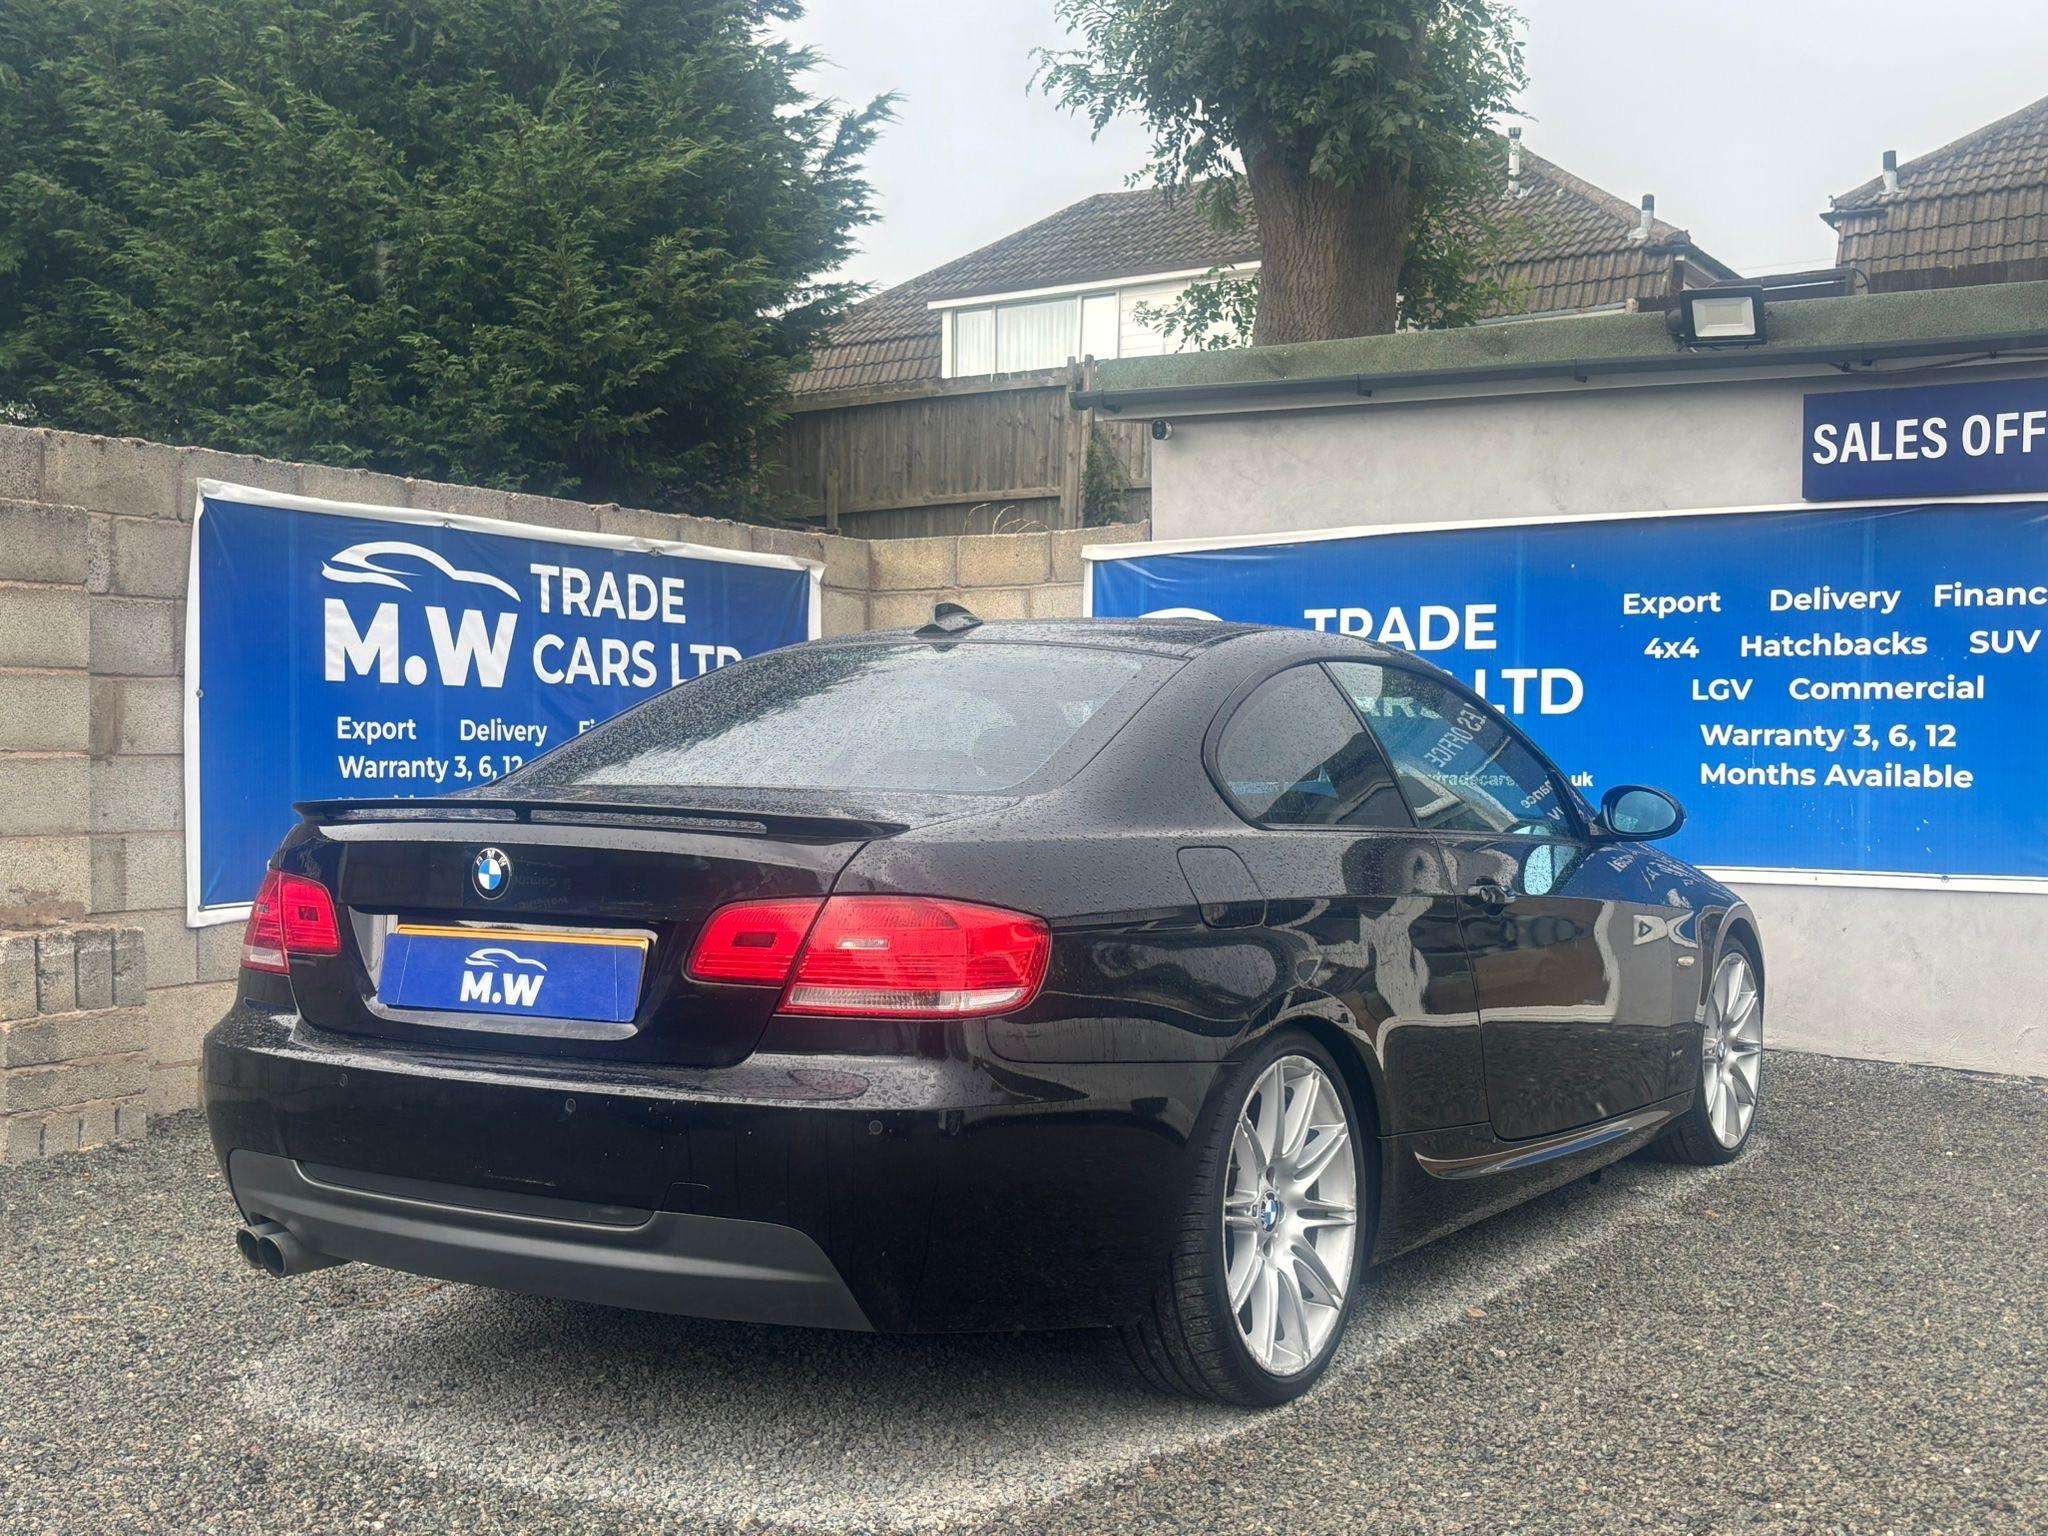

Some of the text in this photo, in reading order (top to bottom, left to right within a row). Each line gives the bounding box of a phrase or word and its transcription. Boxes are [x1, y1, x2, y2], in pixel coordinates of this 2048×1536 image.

[1812, 410, 2047, 464] SALES OFF
[529, 563, 686, 625] TRADE
[1623, 581, 2048, 618] Export Delivery Financ
[325, 598, 519, 688] M.W
[1303, 603, 1497, 651] TRADE
[1644, 629, 2042, 659] 4x4 Hatchbacks SUV
[532, 633, 658, 688] CARS
[1474, 667, 1584, 714] LTD
[1692, 674, 1985, 701] LGV Commercial
[337, 716, 417, 746] Export
[460, 717, 548, 747] Delivery
[1700, 723, 1957, 752] Warranty 3, 6, 12
[338, 755, 449, 784] Warranty
[454, 755, 473, 782] 3,
[1700, 762, 1974, 789] Months Available
[459, 970, 546, 1007] M.W
